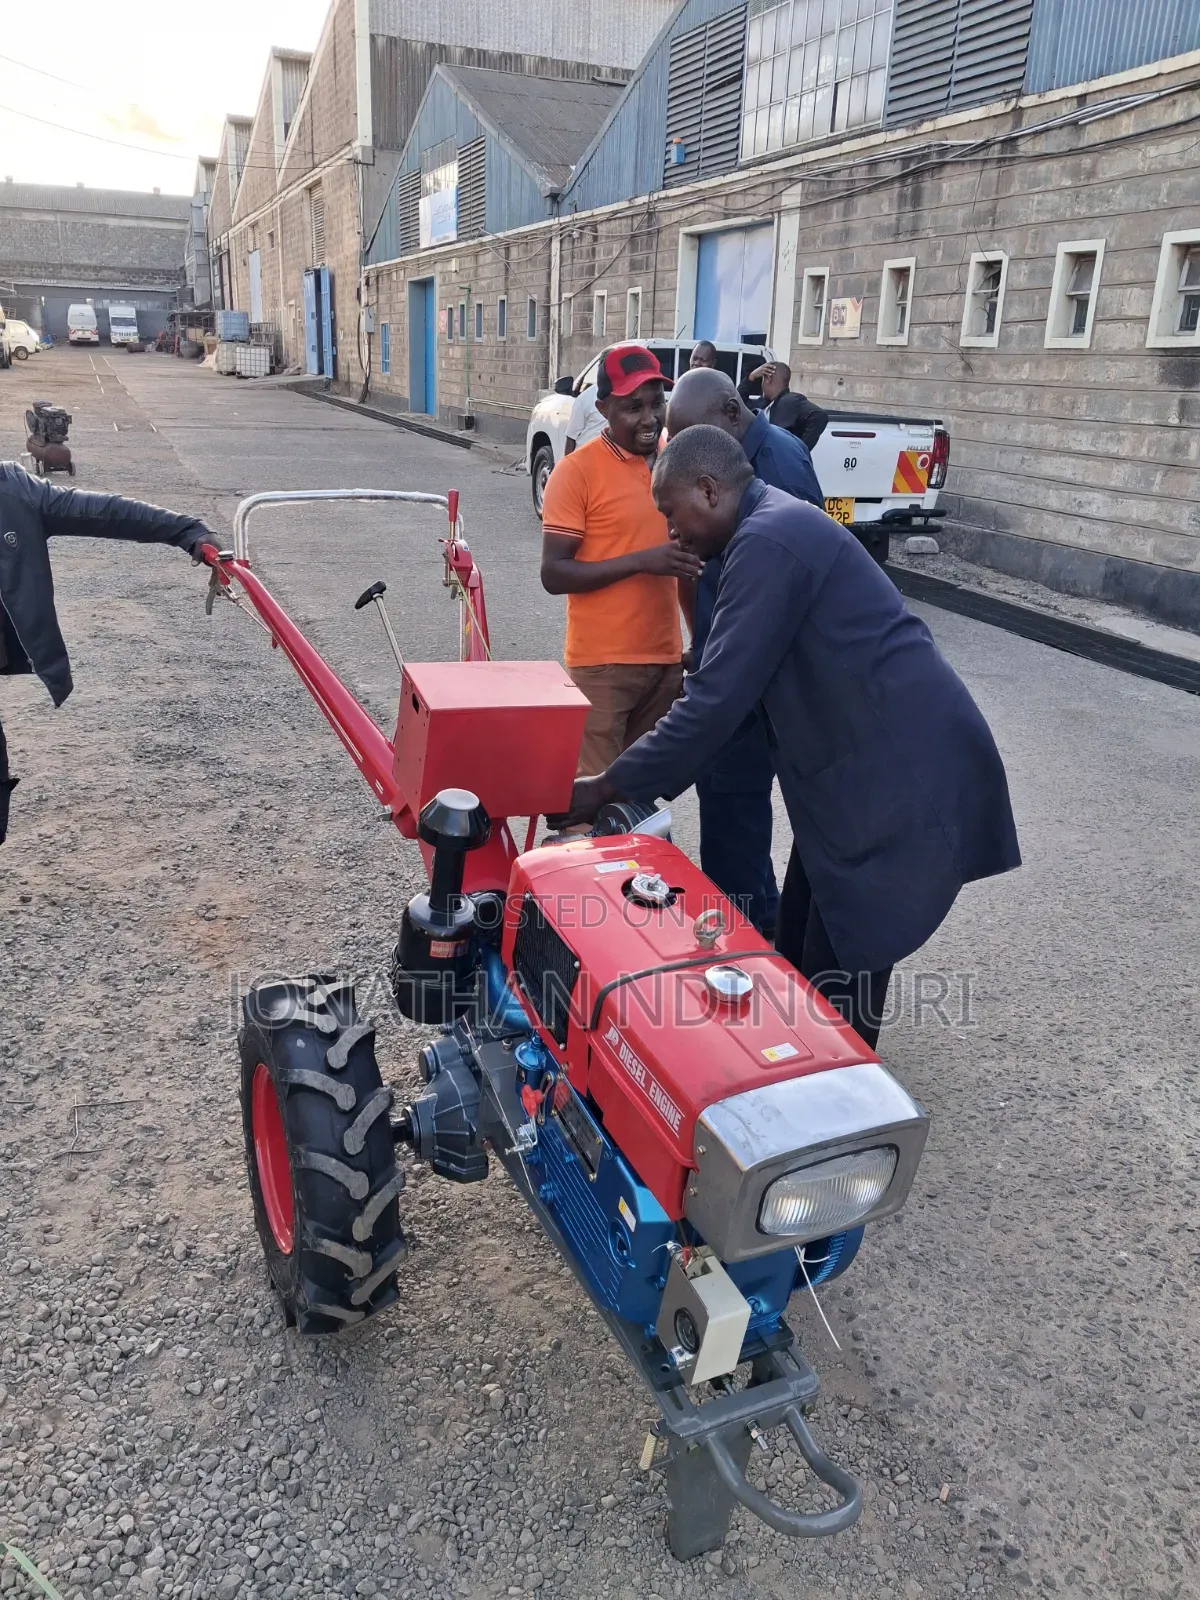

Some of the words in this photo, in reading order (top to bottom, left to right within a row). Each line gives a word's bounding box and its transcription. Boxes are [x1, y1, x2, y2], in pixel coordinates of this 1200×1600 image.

[843, 457, 857, 469] 80
[619, 1042, 647, 1088] DIESEL
[648, 1080, 682, 1131] ENGINE
